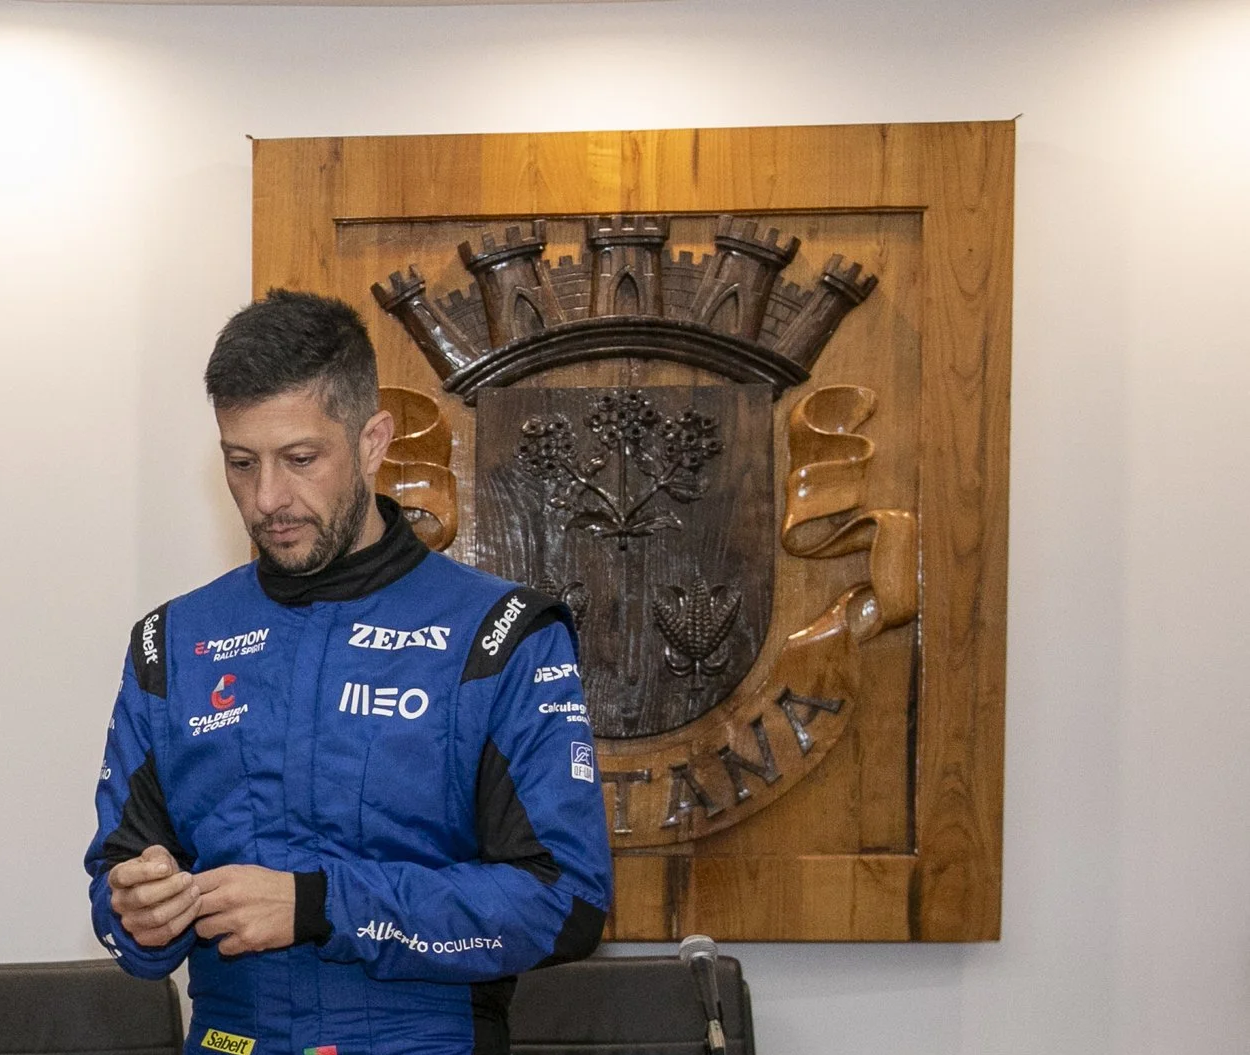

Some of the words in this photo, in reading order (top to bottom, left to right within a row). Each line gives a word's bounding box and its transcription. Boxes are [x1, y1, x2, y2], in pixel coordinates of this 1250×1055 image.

[142, 614, 159, 664] Sabelt
[348, 623, 451, 651] ZEISS
[482, 595, 526, 656] Sabelt
[213, 649, 238, 662] RALLY
[240, 642, 266, 656] SPIRIT
[189, 704, 248, 727] CALDEIRA
[338, 682, 429, 719] MEO
[192, 727, 201, 736] &
[203, 716, 240, 733] COSTA
[600, 685, 846, 833] TANA
[356, 920, 428, 953] Alberto
[432, 935, 502, 953] OCULISTA
[207, 1031, 249, 1054] Sabelt
